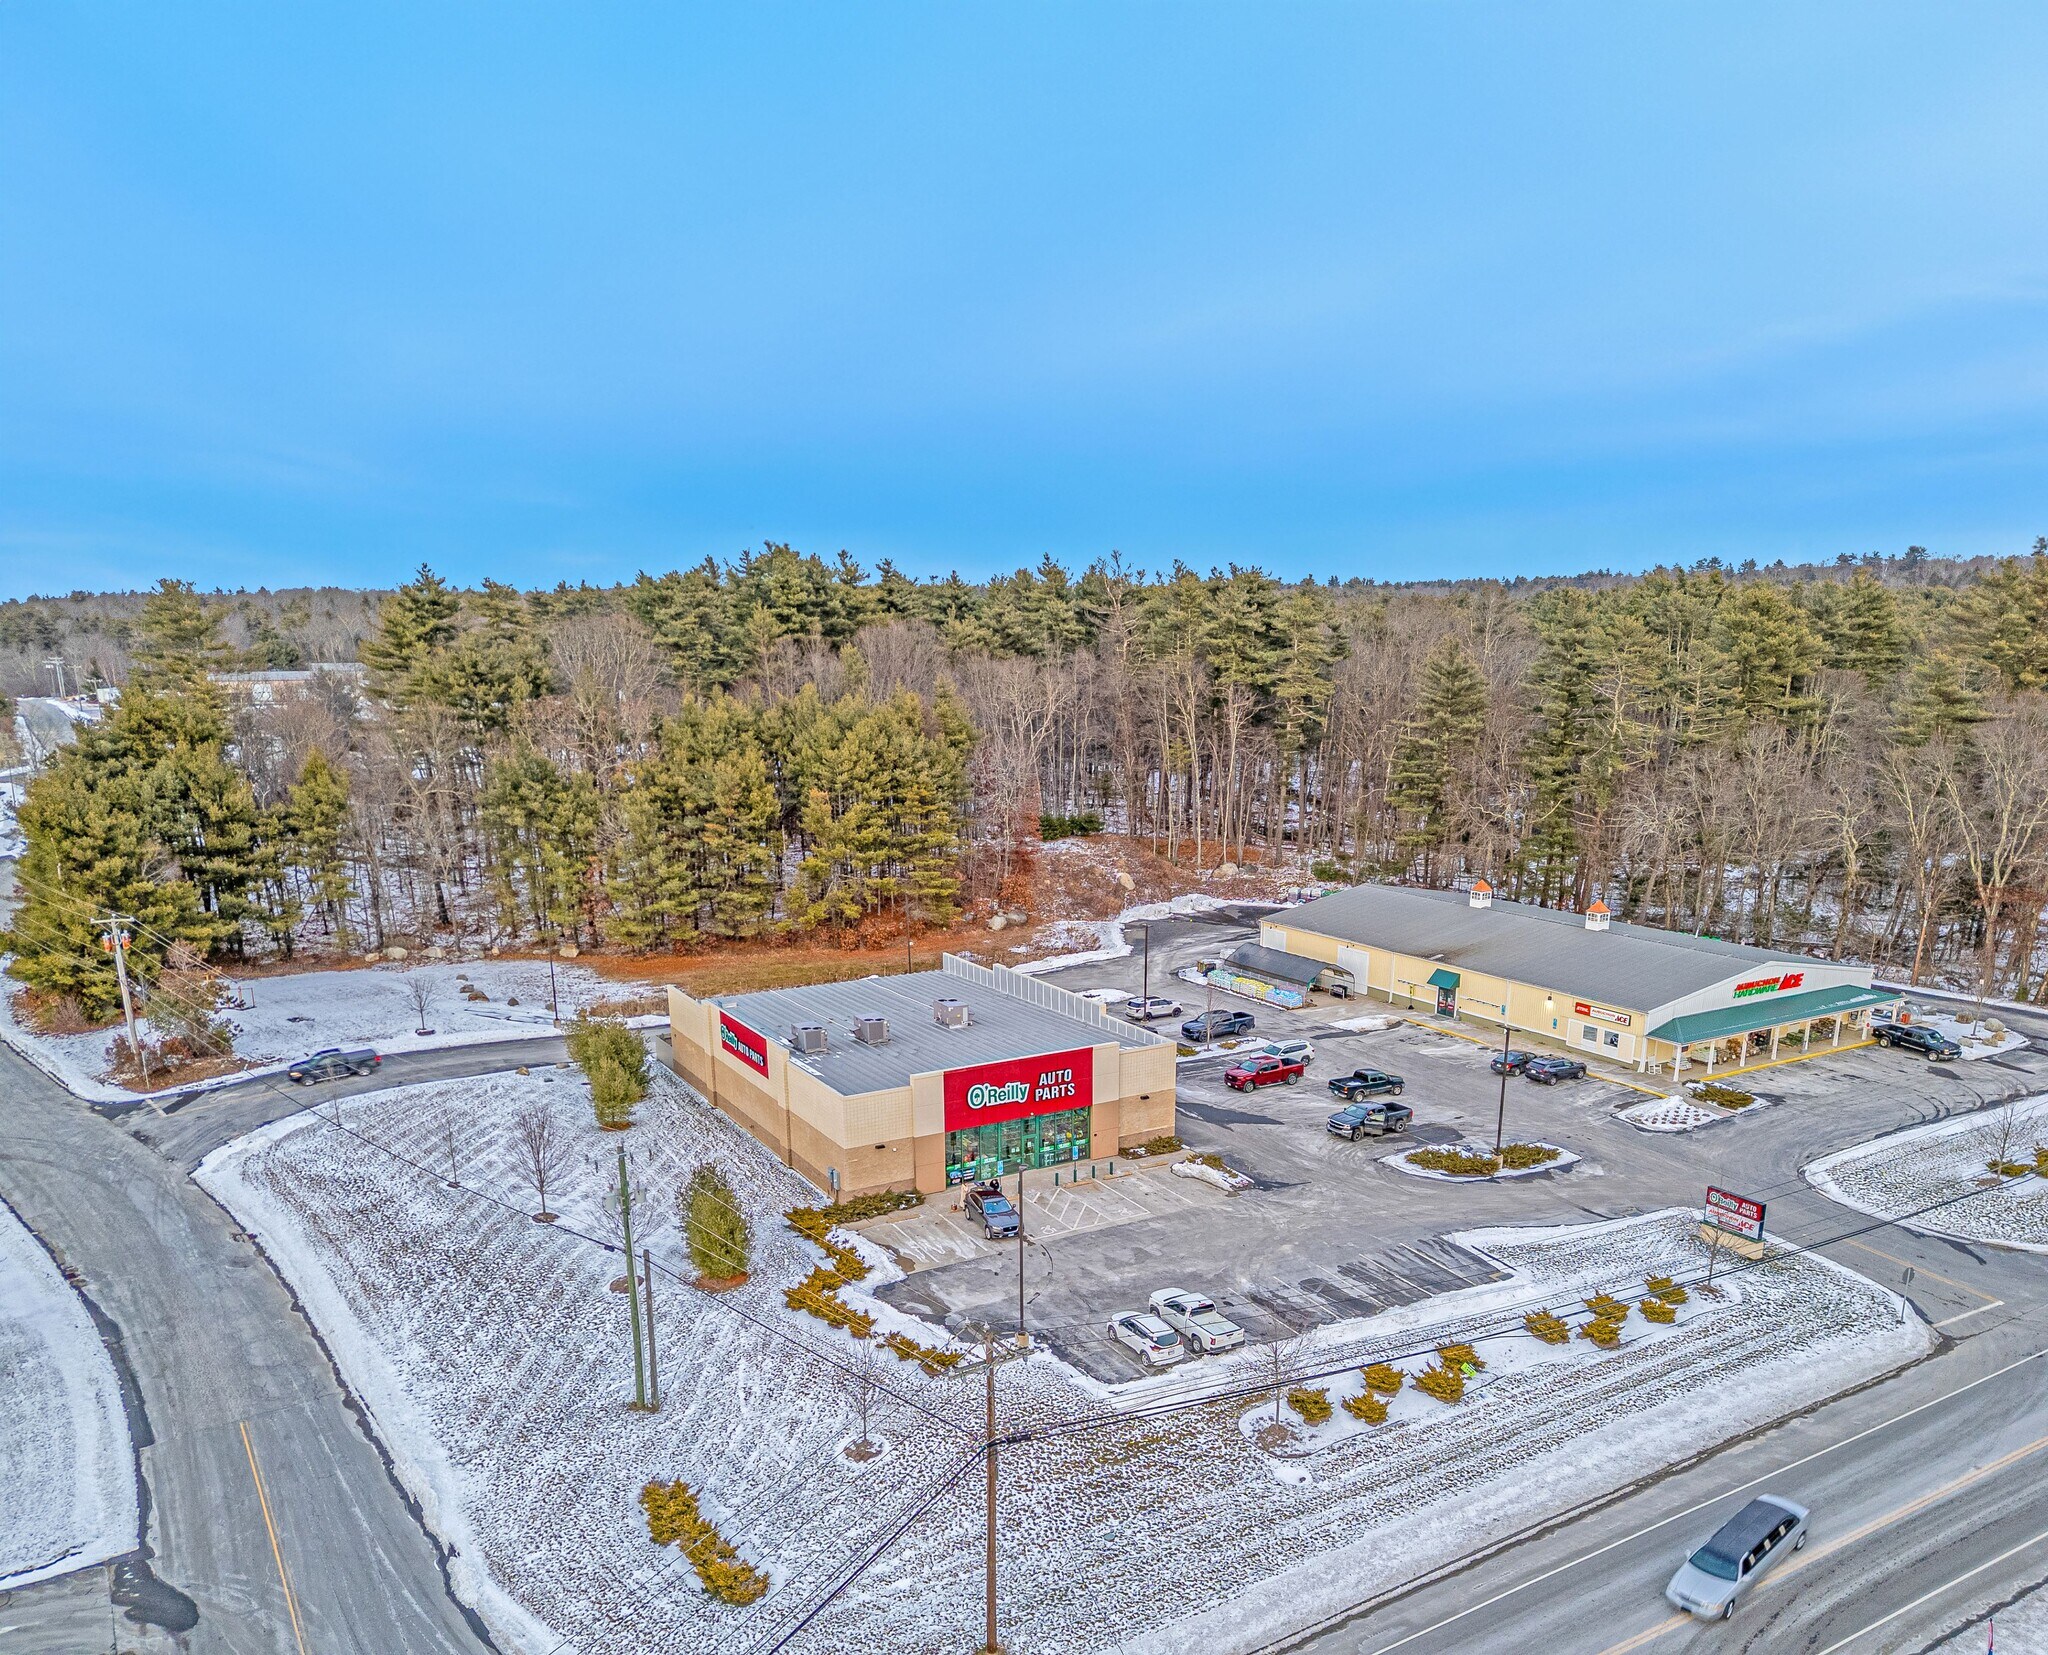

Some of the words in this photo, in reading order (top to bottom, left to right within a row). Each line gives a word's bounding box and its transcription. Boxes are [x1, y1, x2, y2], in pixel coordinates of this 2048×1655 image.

[1778, 972, 1804, 990] ACE
[1615, 1015, 1628, 1023] ACE
[1039, 1069, 1072, 1086] AUTO
[968, 1082, 1030, 1109] O'Reilly
[1035, 1083, 1075, 1102] PARTS
[1740, 1207, 1758, 1219] PARTS
[1741, 1202, 1757, 1212] AUTO
[1738, 1220, 1755, 1231] ACE
